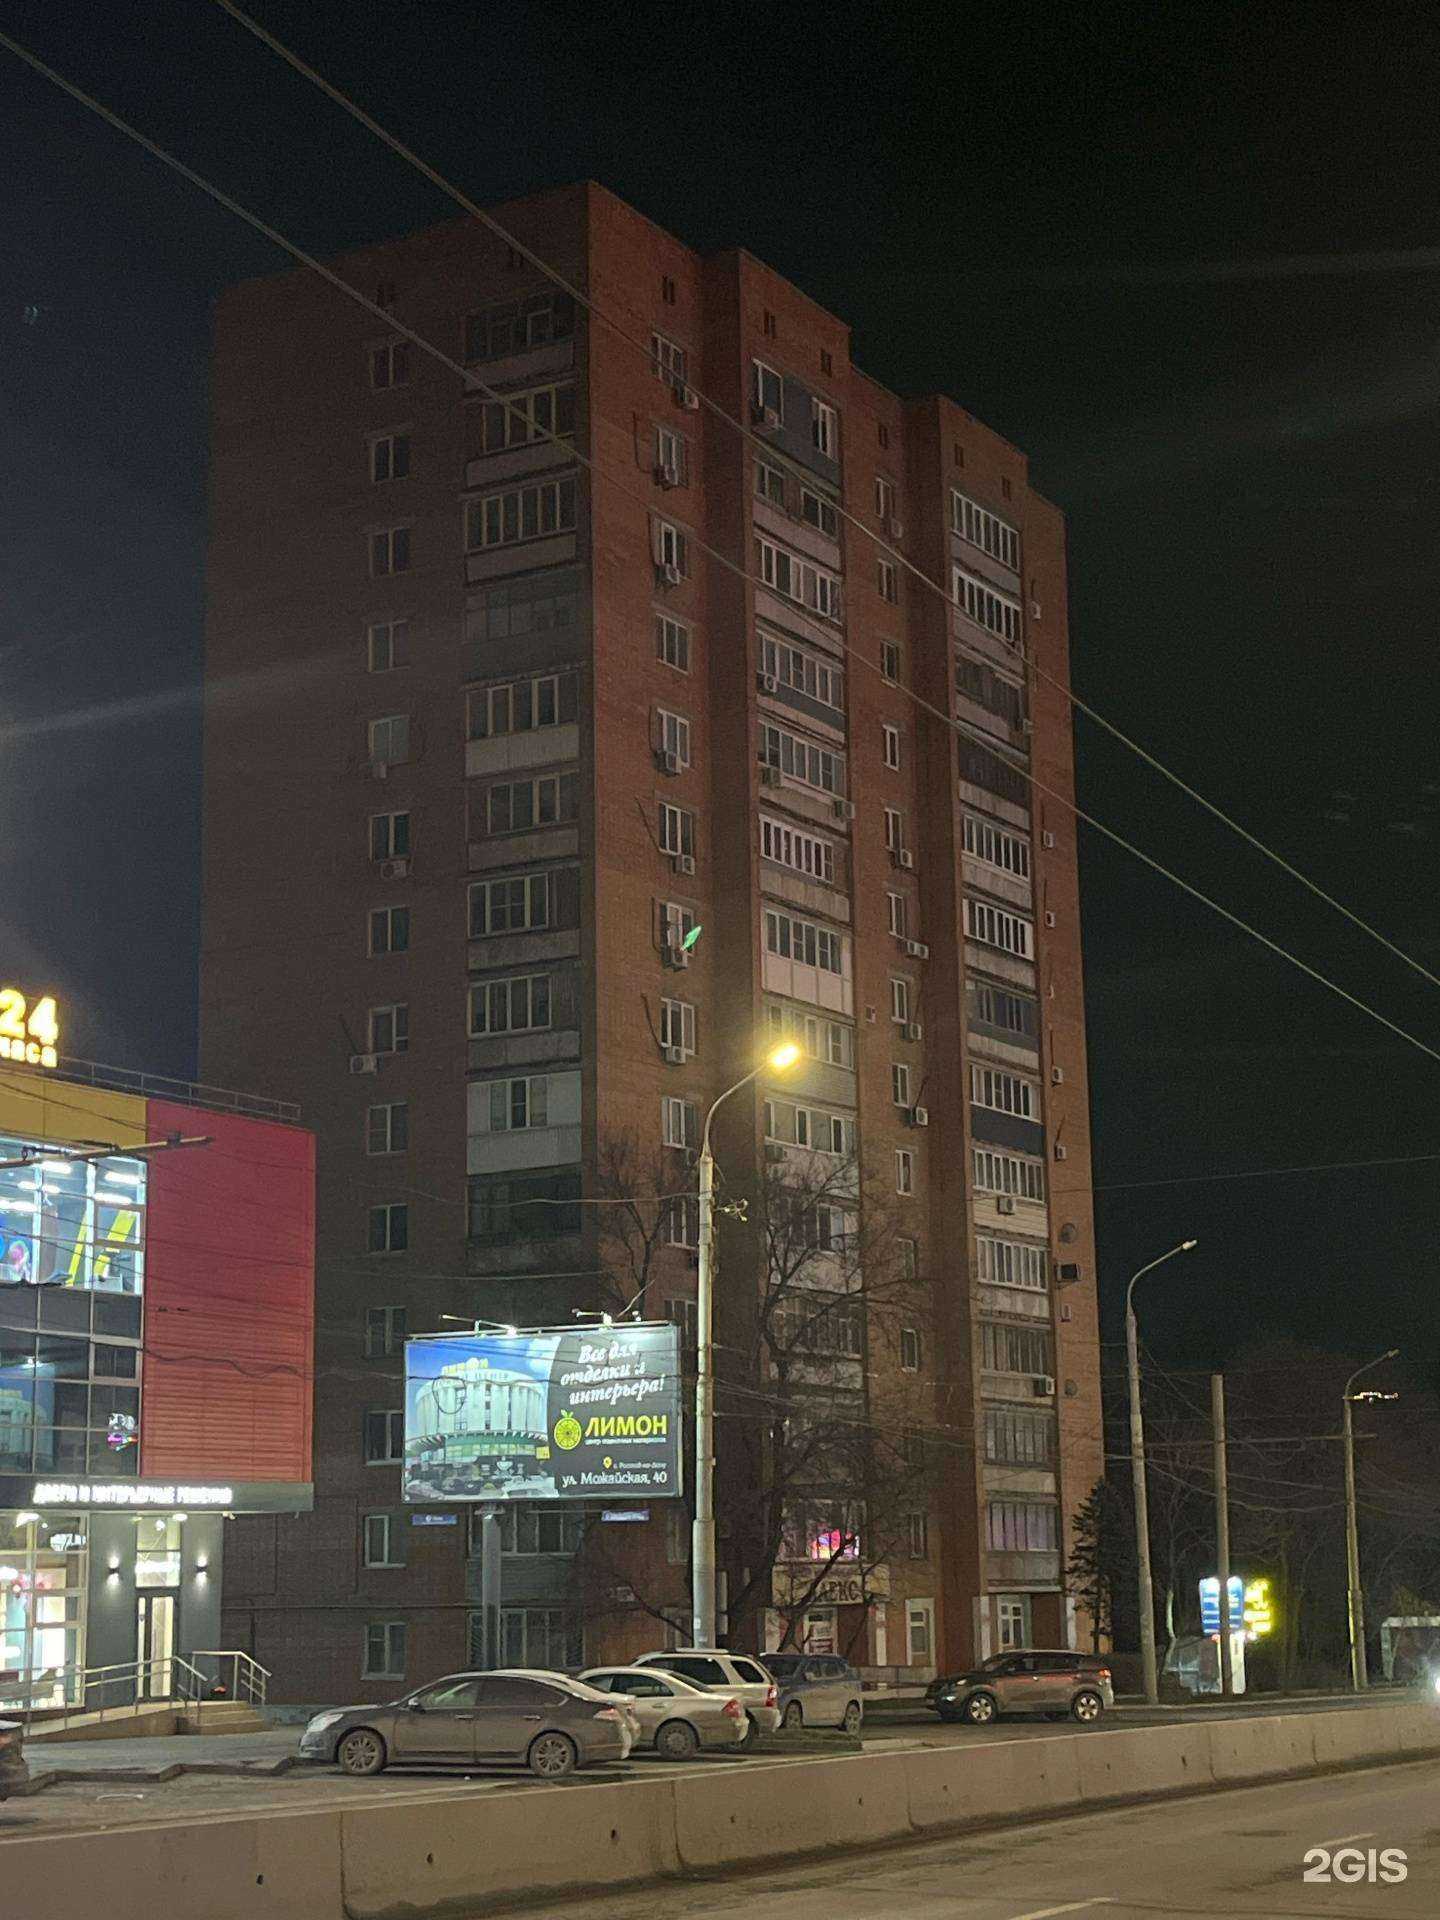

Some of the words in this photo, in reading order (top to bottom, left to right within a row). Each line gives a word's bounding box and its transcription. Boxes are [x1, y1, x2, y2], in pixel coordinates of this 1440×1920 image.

[578, 1345, 608, 1363] Все
[569, 1373, 666, 1405] интерьера!
[585, 1414, 667, 1437] ЛИМОН
[653, 1470, 668, 1484] 40
